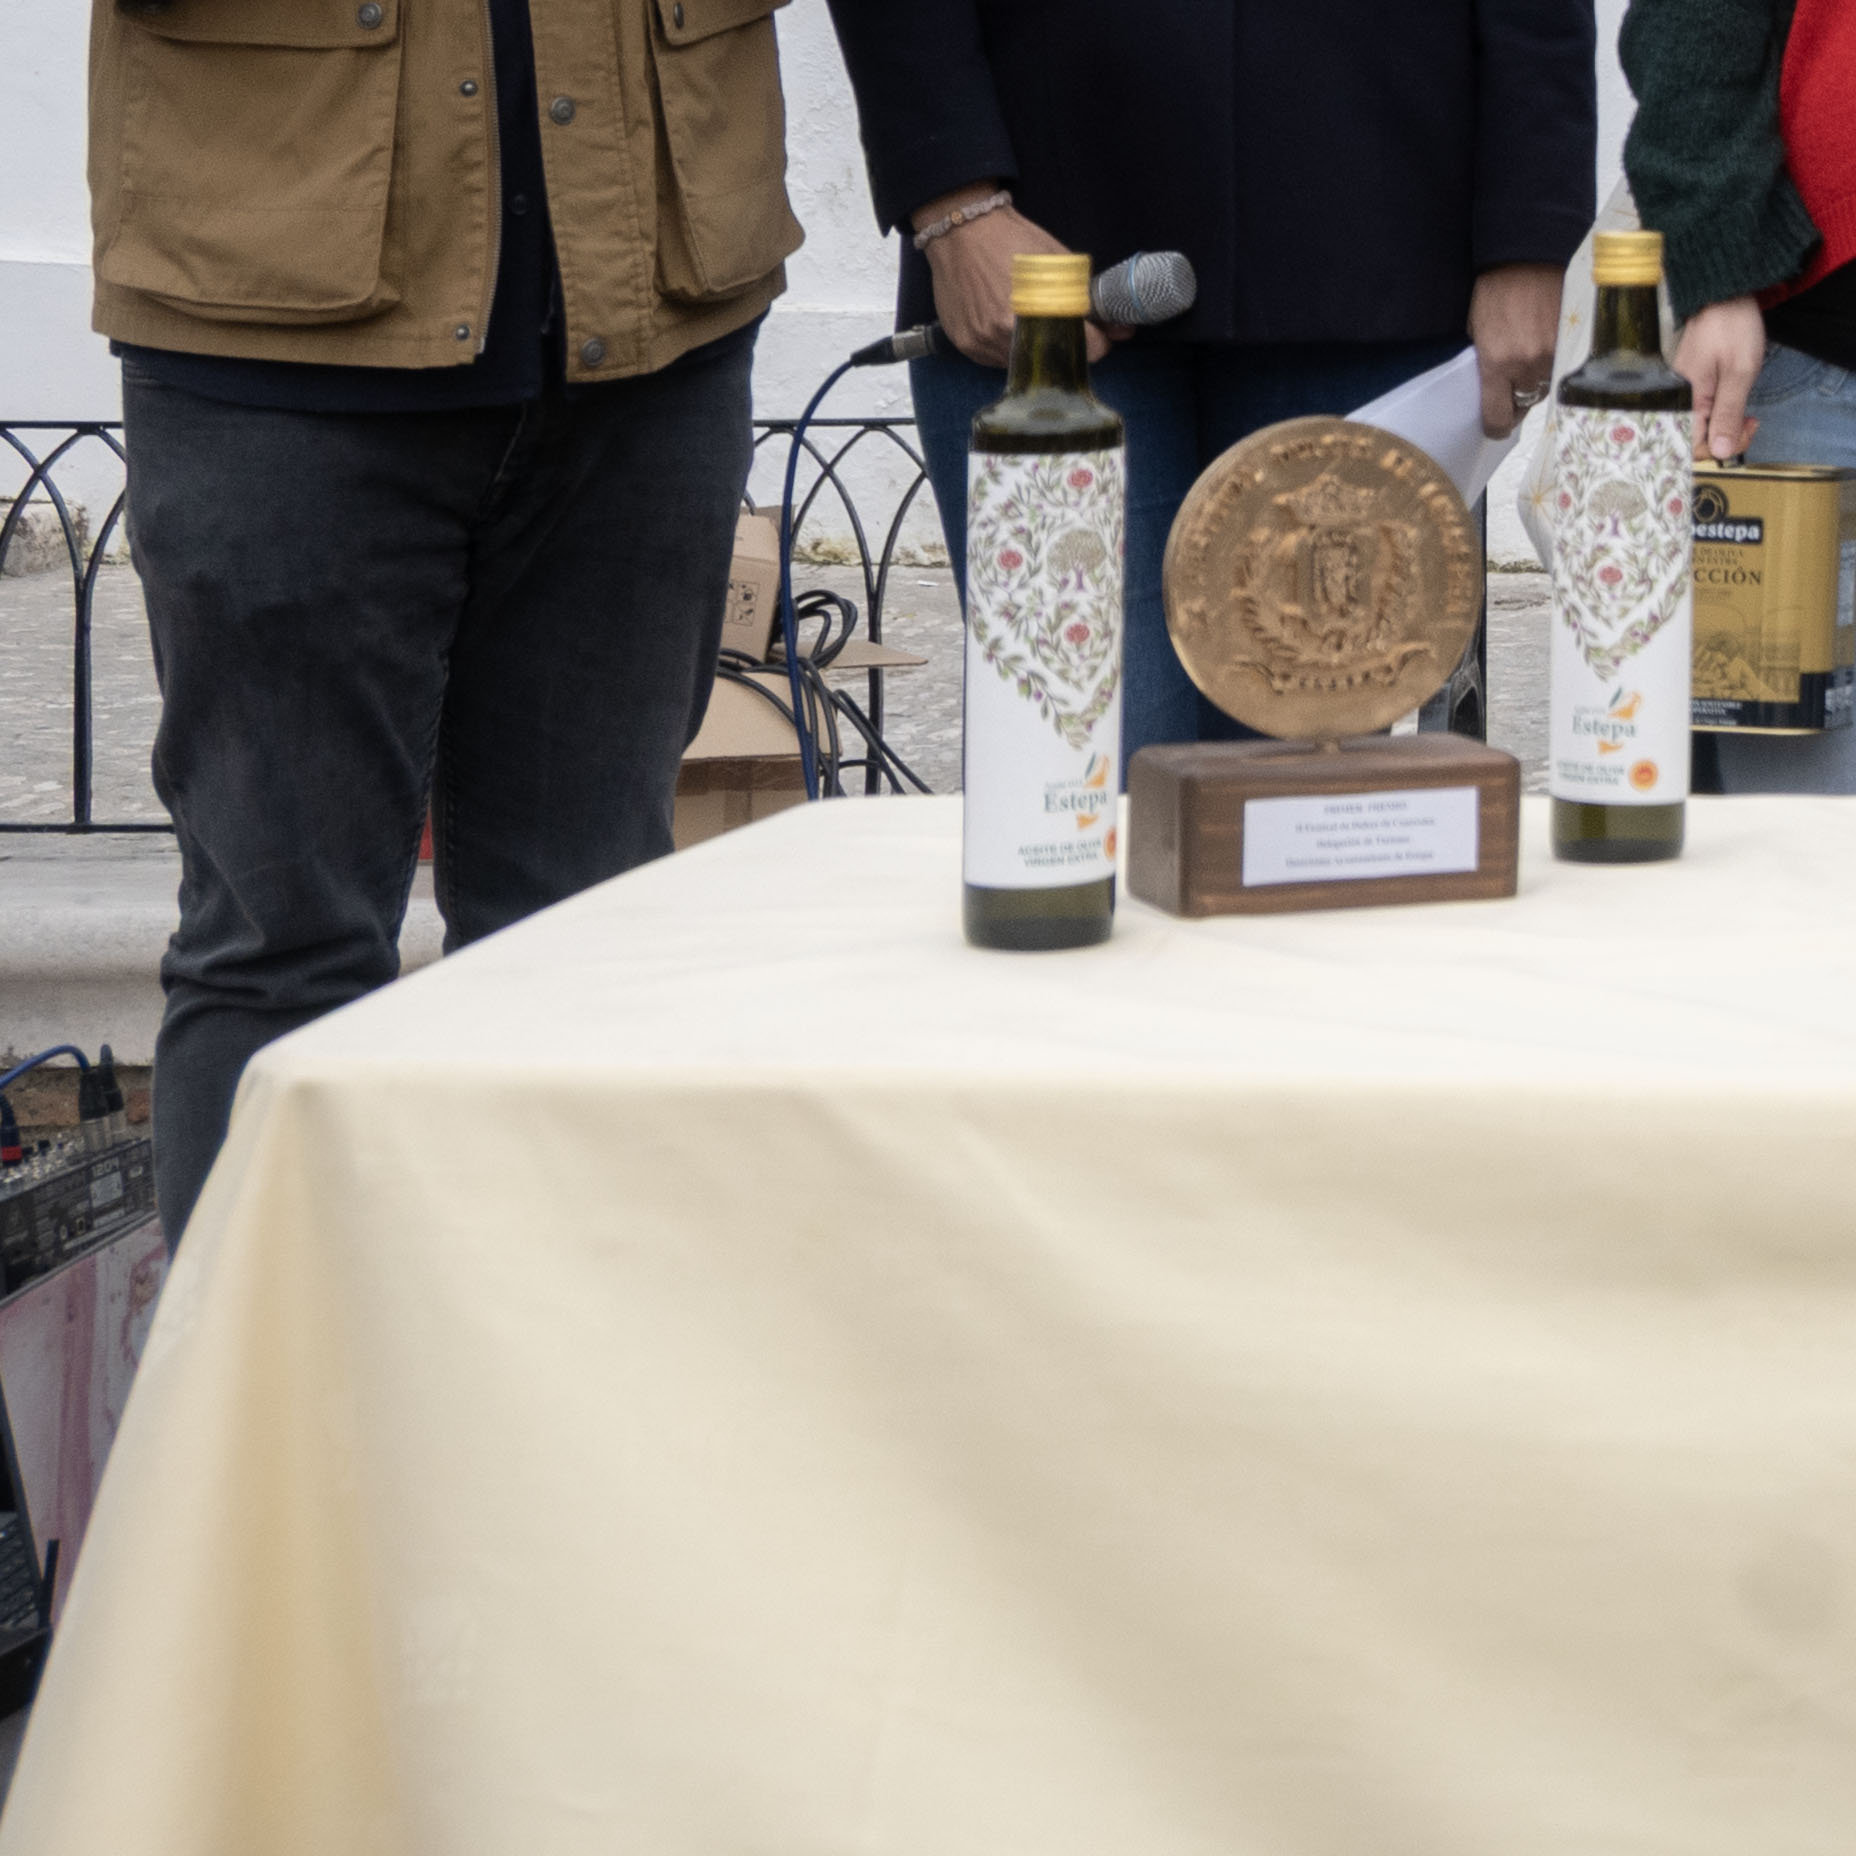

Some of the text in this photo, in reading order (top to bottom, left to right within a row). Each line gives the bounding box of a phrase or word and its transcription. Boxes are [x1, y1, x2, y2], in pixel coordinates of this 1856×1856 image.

[1692, 523, 1760, 542] estepa
[1693, 566, 1762, 585] CCIÓN
[1572, 715, 1636, 743] Estepa
[1044, 792, 1107, 813] Estepa
